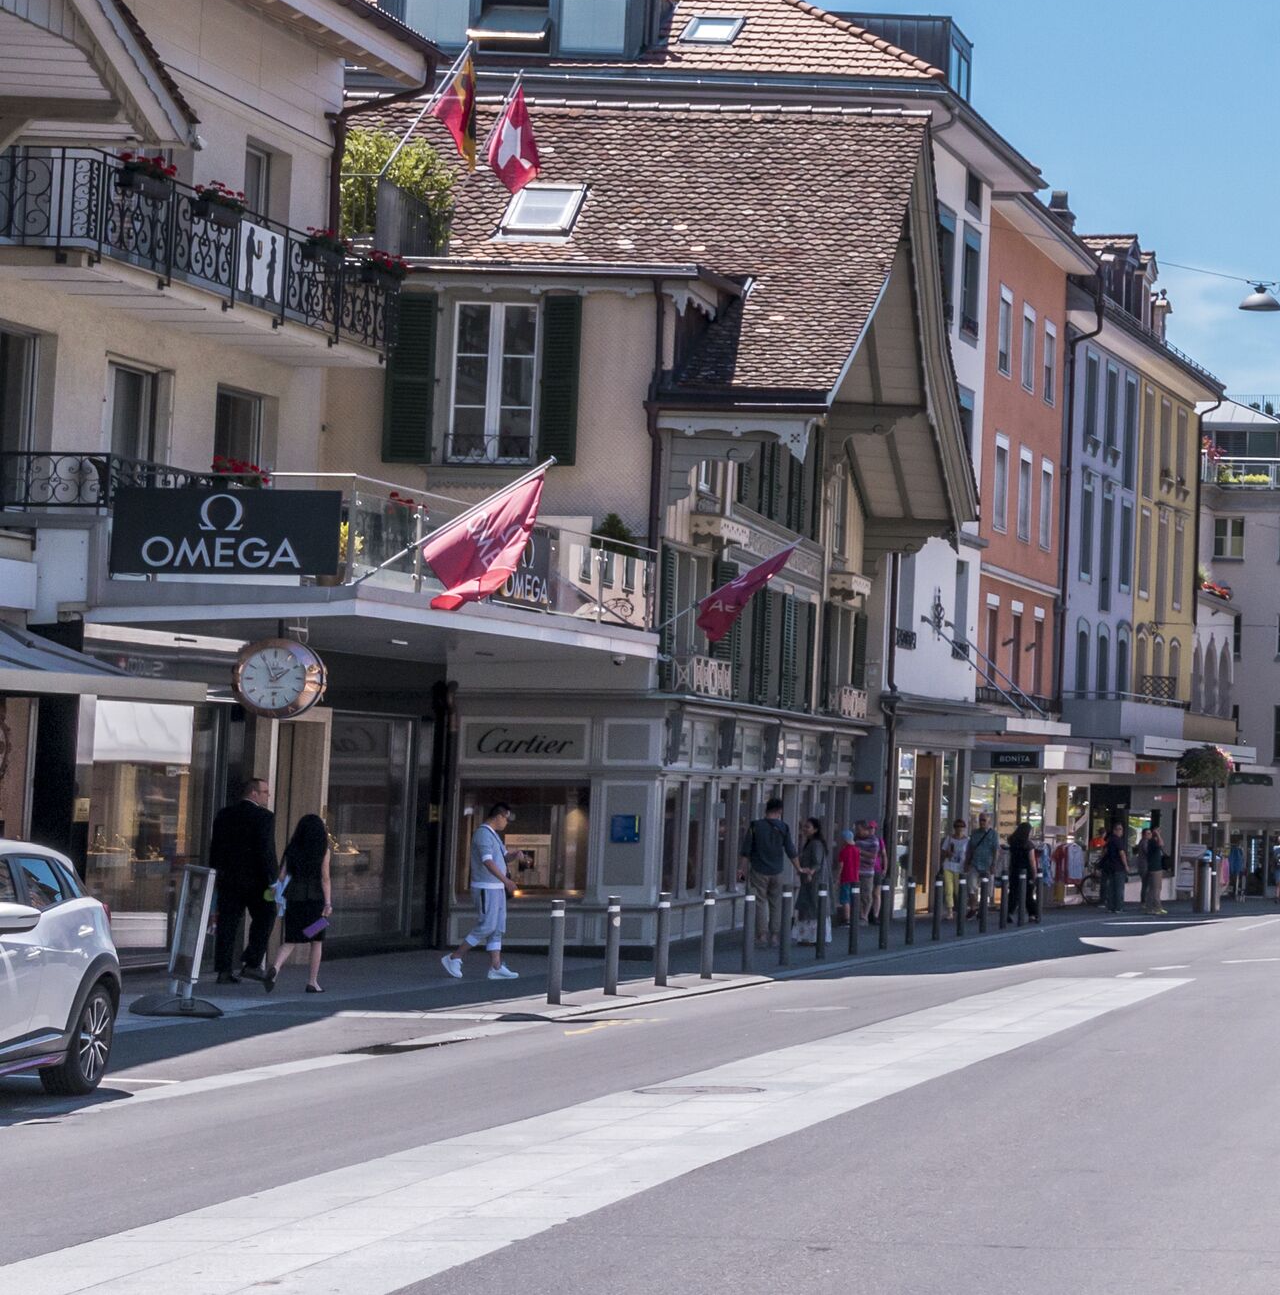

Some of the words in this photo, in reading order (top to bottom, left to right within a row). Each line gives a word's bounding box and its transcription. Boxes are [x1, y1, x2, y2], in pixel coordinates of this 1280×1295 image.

[141, 536, 301, 568] OMEGA
[504, 571, 549, 604] OMEGA
[477, 727, 574, 754] Cartier
